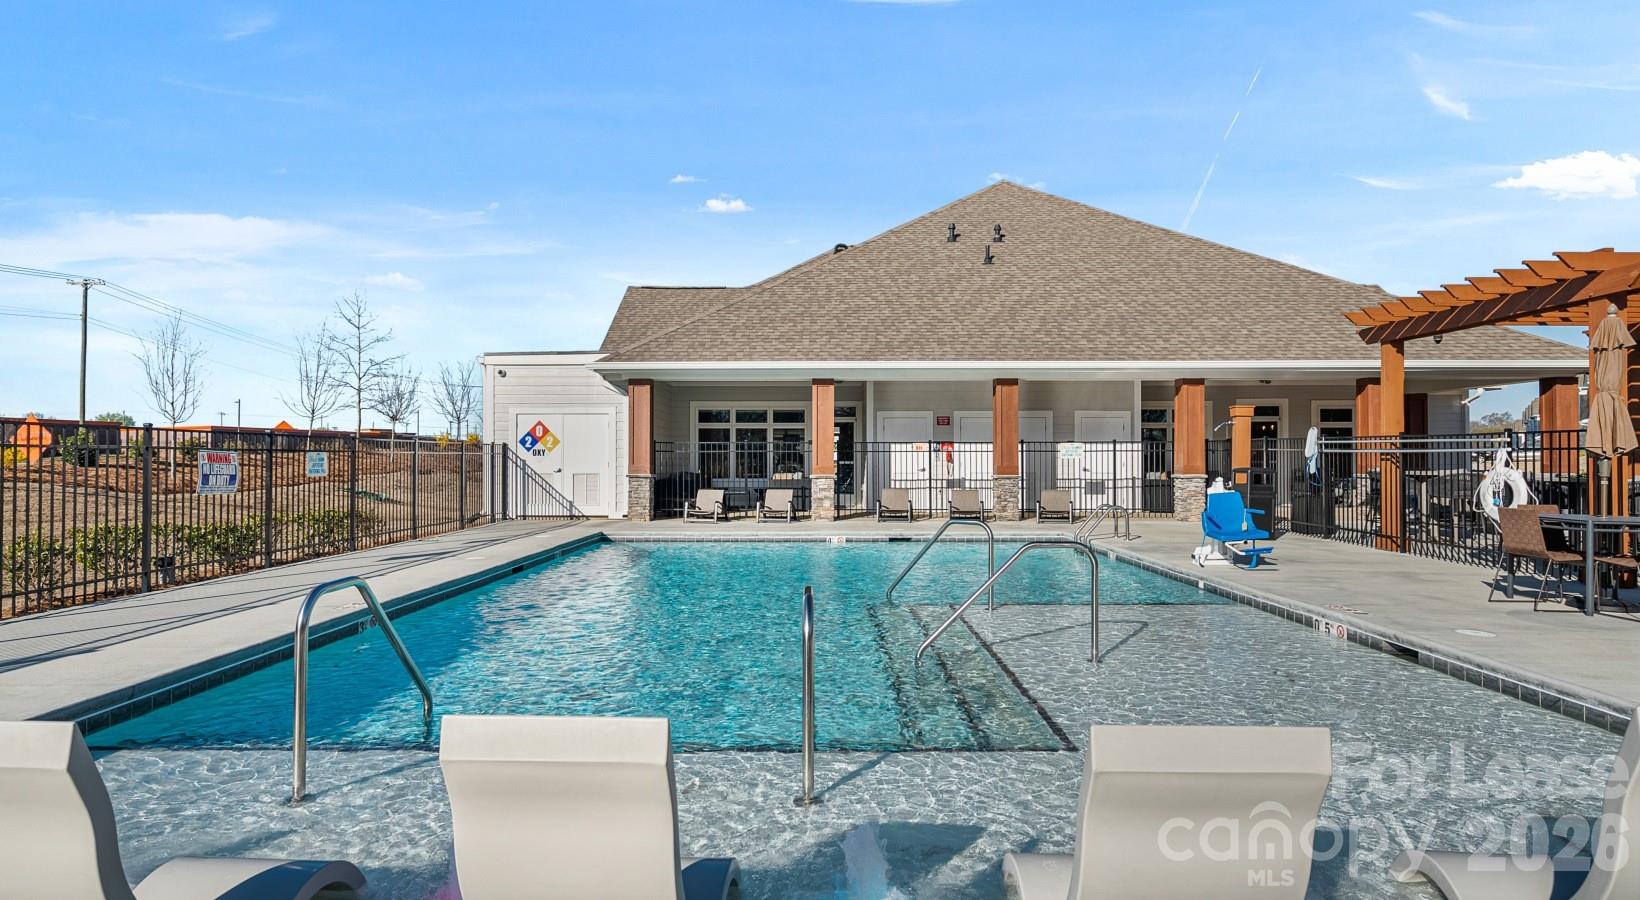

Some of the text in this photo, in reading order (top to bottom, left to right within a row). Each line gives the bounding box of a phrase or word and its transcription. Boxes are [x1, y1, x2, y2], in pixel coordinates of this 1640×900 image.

[536, 425, 543, 437] 0
[525, 436, 532, 447] 2
[547, 437, 553, 447] 2
[207, 453, 232, 463] WARNING
[203, 464, 236, 475] NO LIFEGUARD
[209, 475, 230, 486] ON DUTY
[1324, 622, 1330, 634] 5
